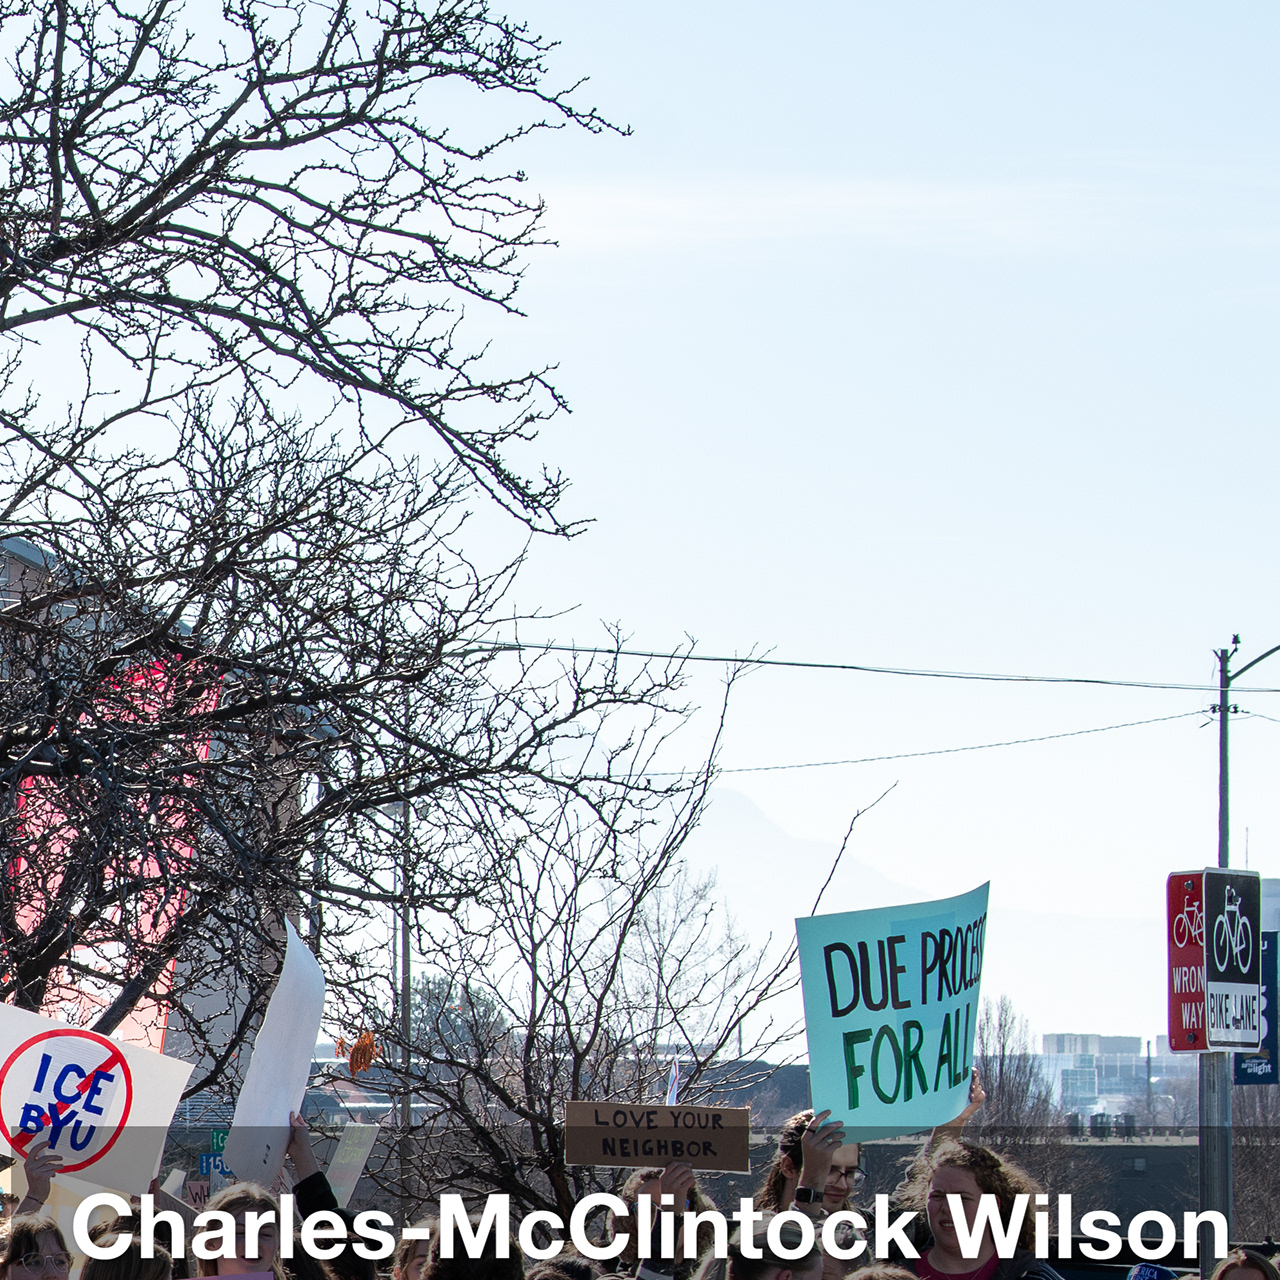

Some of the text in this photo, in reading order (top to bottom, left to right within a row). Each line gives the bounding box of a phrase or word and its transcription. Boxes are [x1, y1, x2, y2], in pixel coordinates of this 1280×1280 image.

[823, 911, 987, 1018] DUE PROCESS
[1181, 1002, 1205, 1029] WAY
[1210, 993, 1230, 1029] BIKE
[1233, 994, 1257, 1030] LANE
[842, 1003, 971, 1111] FOR ALL
[1252, 1062, 1272, 1075] light
[33, 1053, 115, 1116] ICE
[19, 1102, 97, 1151] BYU
[594, 1109, 724, 1130] LOVE YOUR
[602, 1137, 718, 1158] NEIGHBOR
